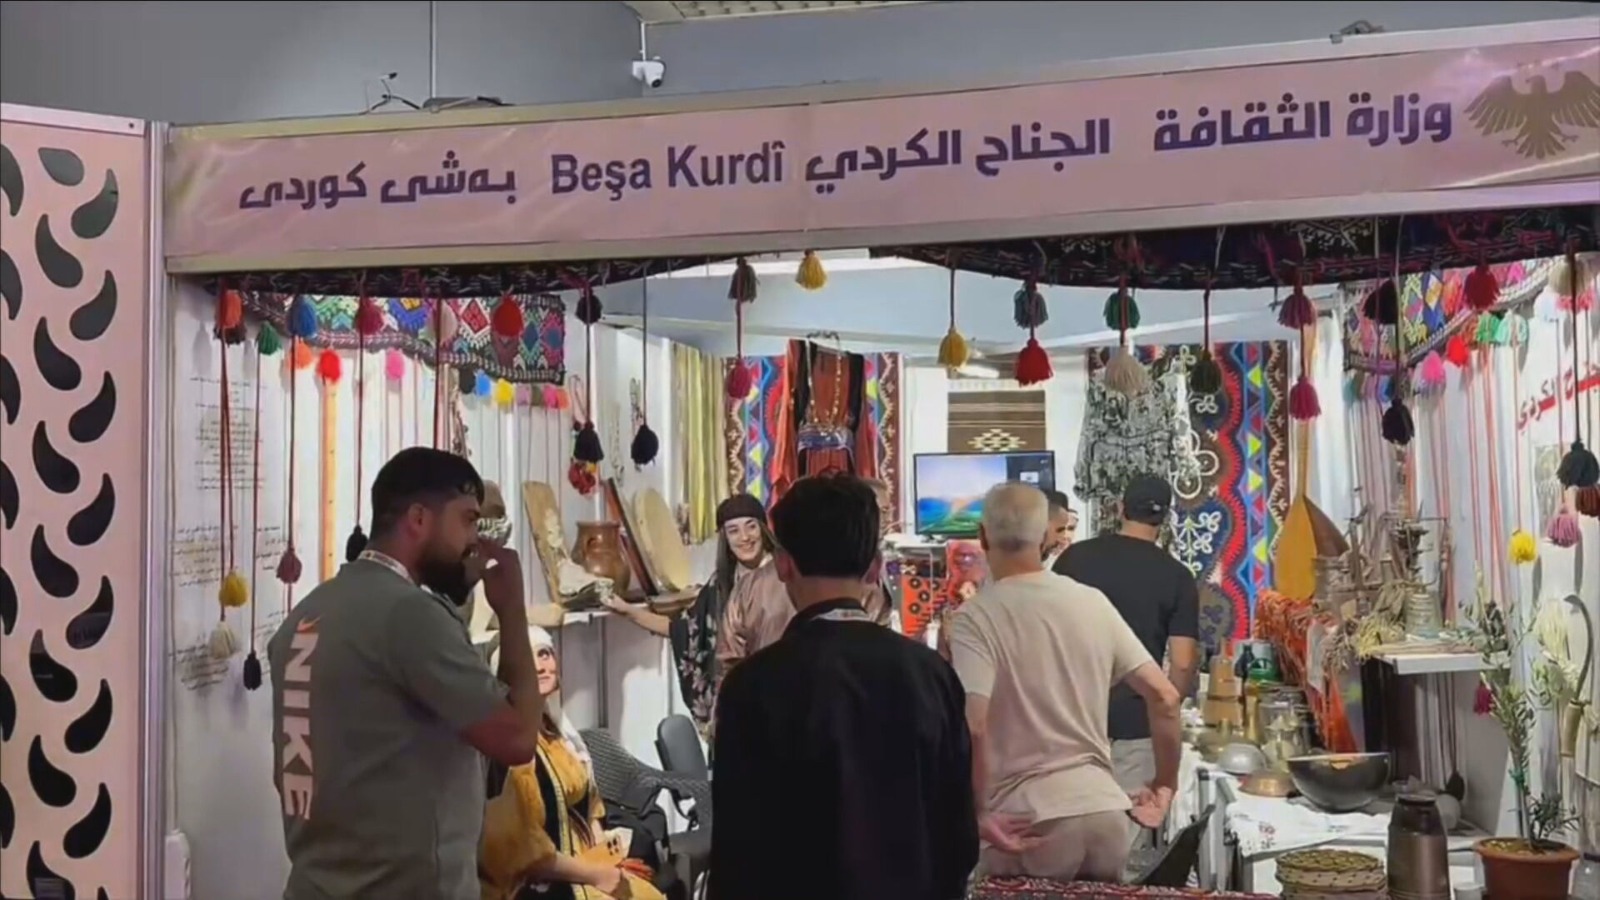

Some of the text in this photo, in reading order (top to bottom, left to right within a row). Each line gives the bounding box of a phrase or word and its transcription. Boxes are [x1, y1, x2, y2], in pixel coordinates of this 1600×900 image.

[1153, 91, 1452, 152] وزارة الثقافة
[552, 140, 786, 202] Beşa Kurdî
[805, 118, 1110, 195] الجناح الكردي
[283, 632, 319, 820] NIKE
